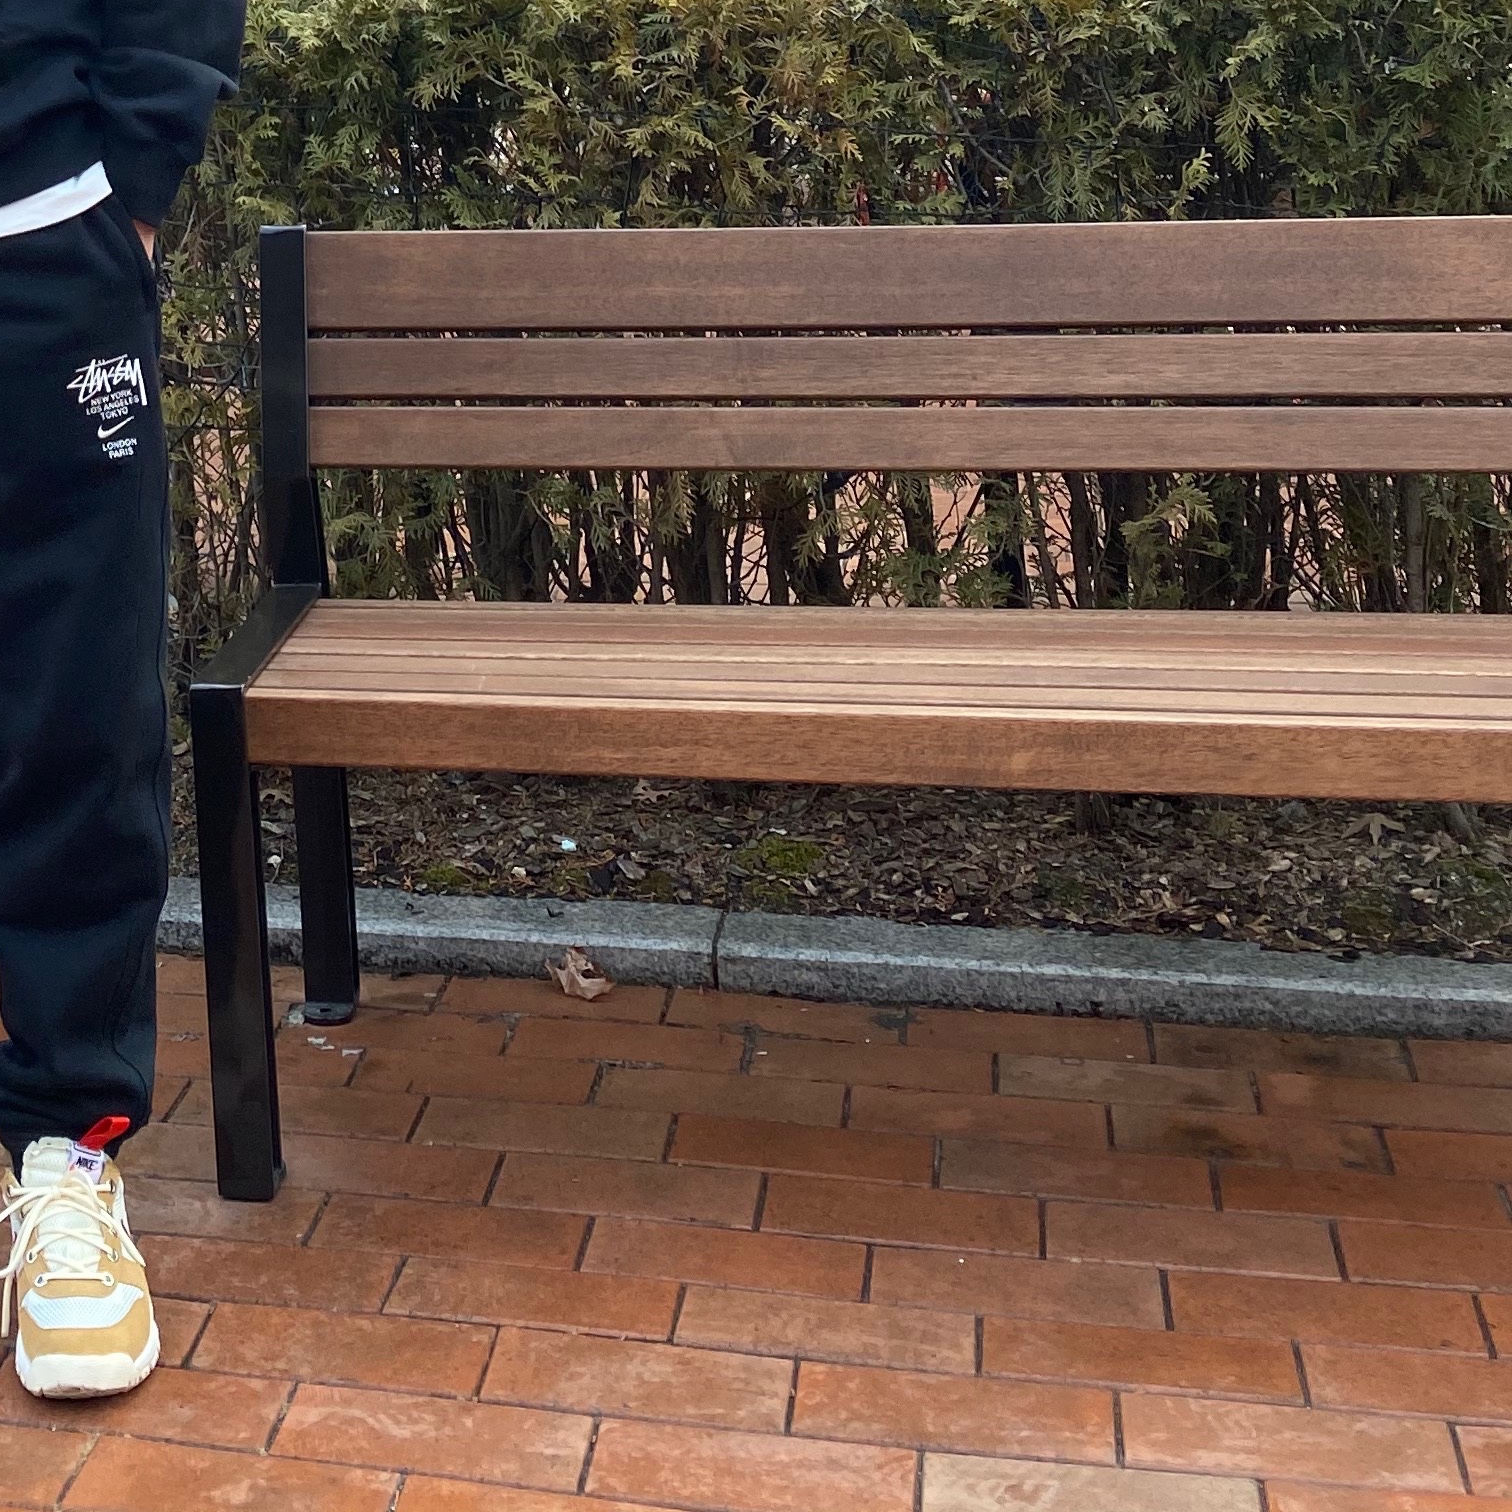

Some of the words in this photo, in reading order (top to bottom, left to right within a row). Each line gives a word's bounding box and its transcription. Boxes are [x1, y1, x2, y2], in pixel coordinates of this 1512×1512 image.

[90, 395, 109, 406] NEW
[110, 389, 133, 401] YORK
[85, 406, 102, 416] LOS
[104, 394, 140, 411] ANGELES
[100, 407, 128, 421] TOKYO
[102, 438, 138, 452] LONDON
[108, 447, 134, 460] PARIS
